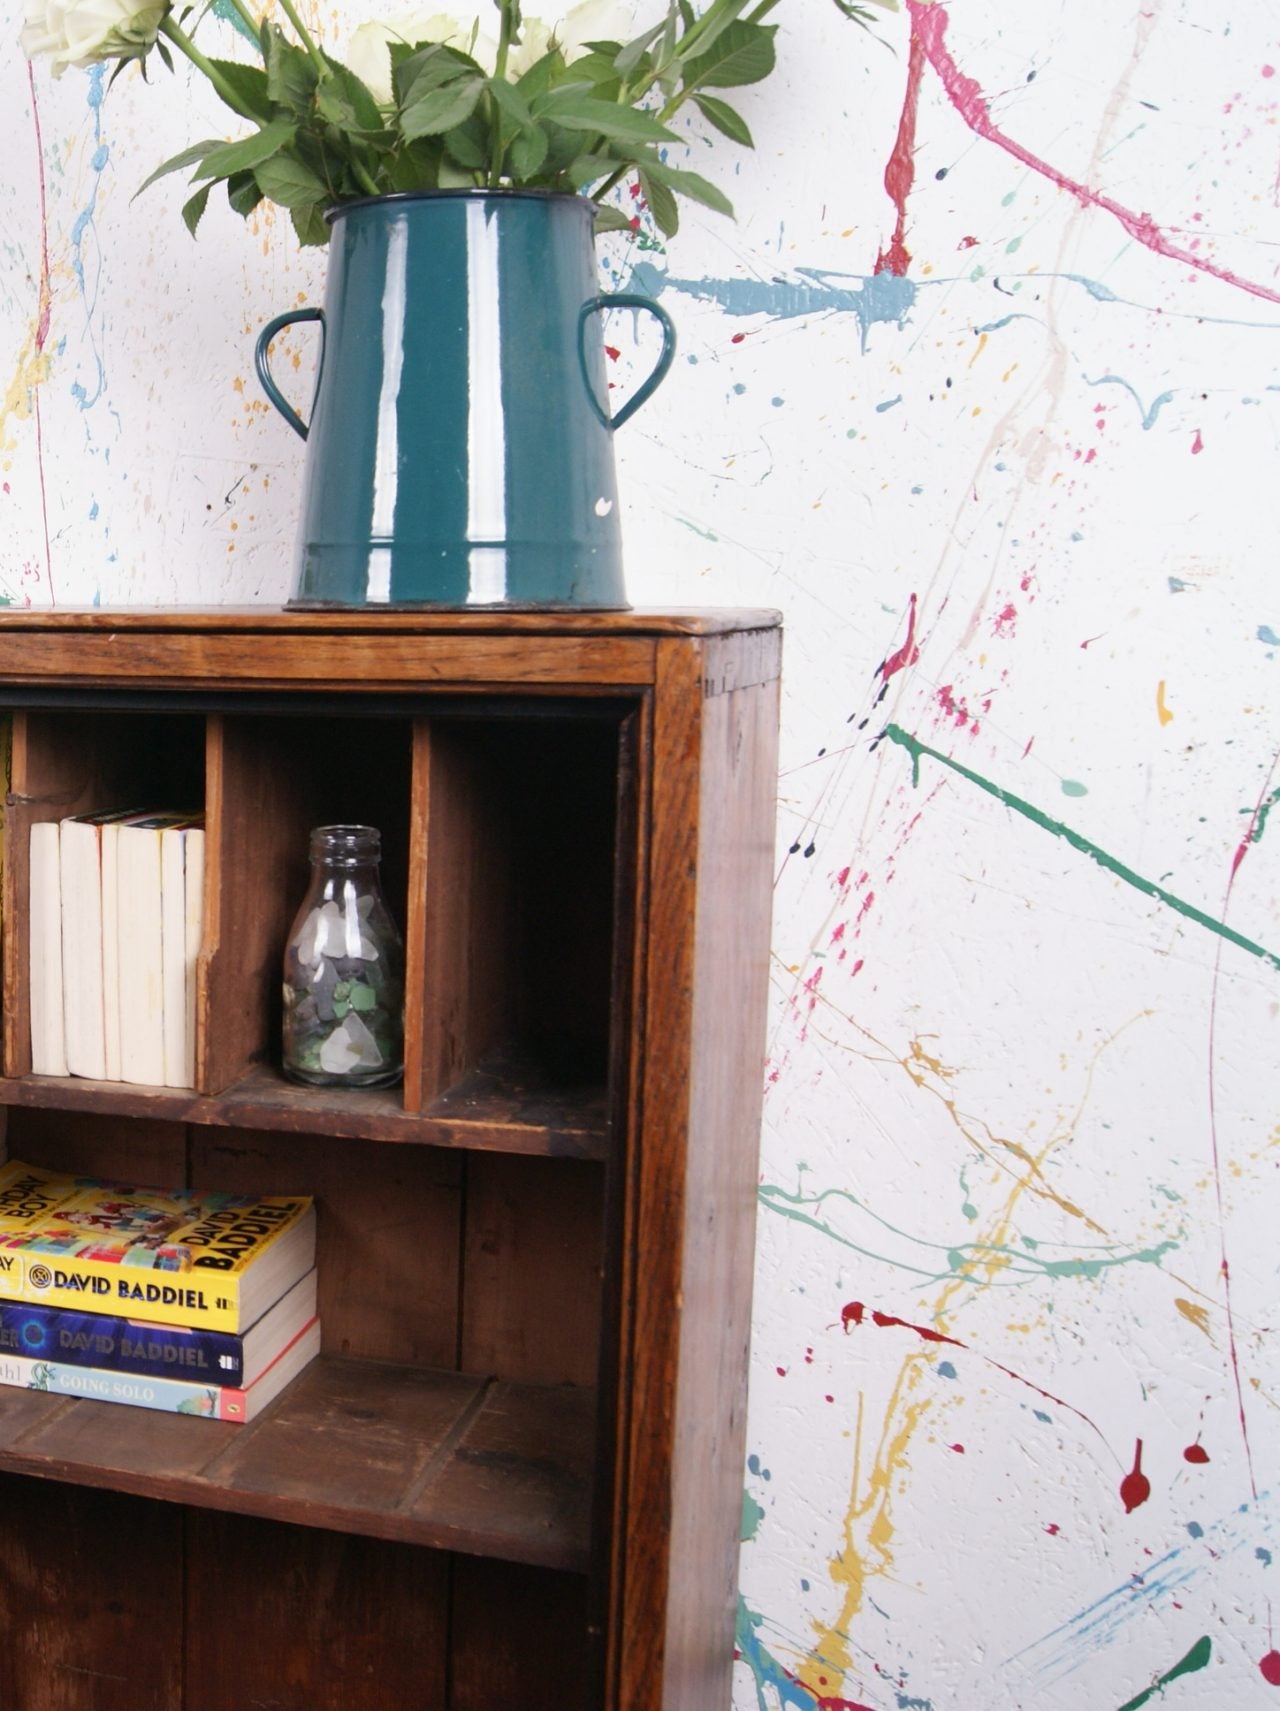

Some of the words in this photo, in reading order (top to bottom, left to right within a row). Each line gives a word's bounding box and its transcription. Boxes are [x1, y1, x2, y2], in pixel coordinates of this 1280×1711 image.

[4, 1194, 58, 1218] BOY
[179, 1211, 240, 1246] DAVID
[193, 1202, 298, 1271] BADDIEL
[54, 1270, 111, 1295] DAVID
[118, 1280, 208, 1310] BADDIEL
[60, 1330, 115, 1354] DAVID
[120, 1339, 208, 1368] BADDIEL
[60, 1374, 109, 1395] GOING
[113, 1383, 154, 1402] SOLO
